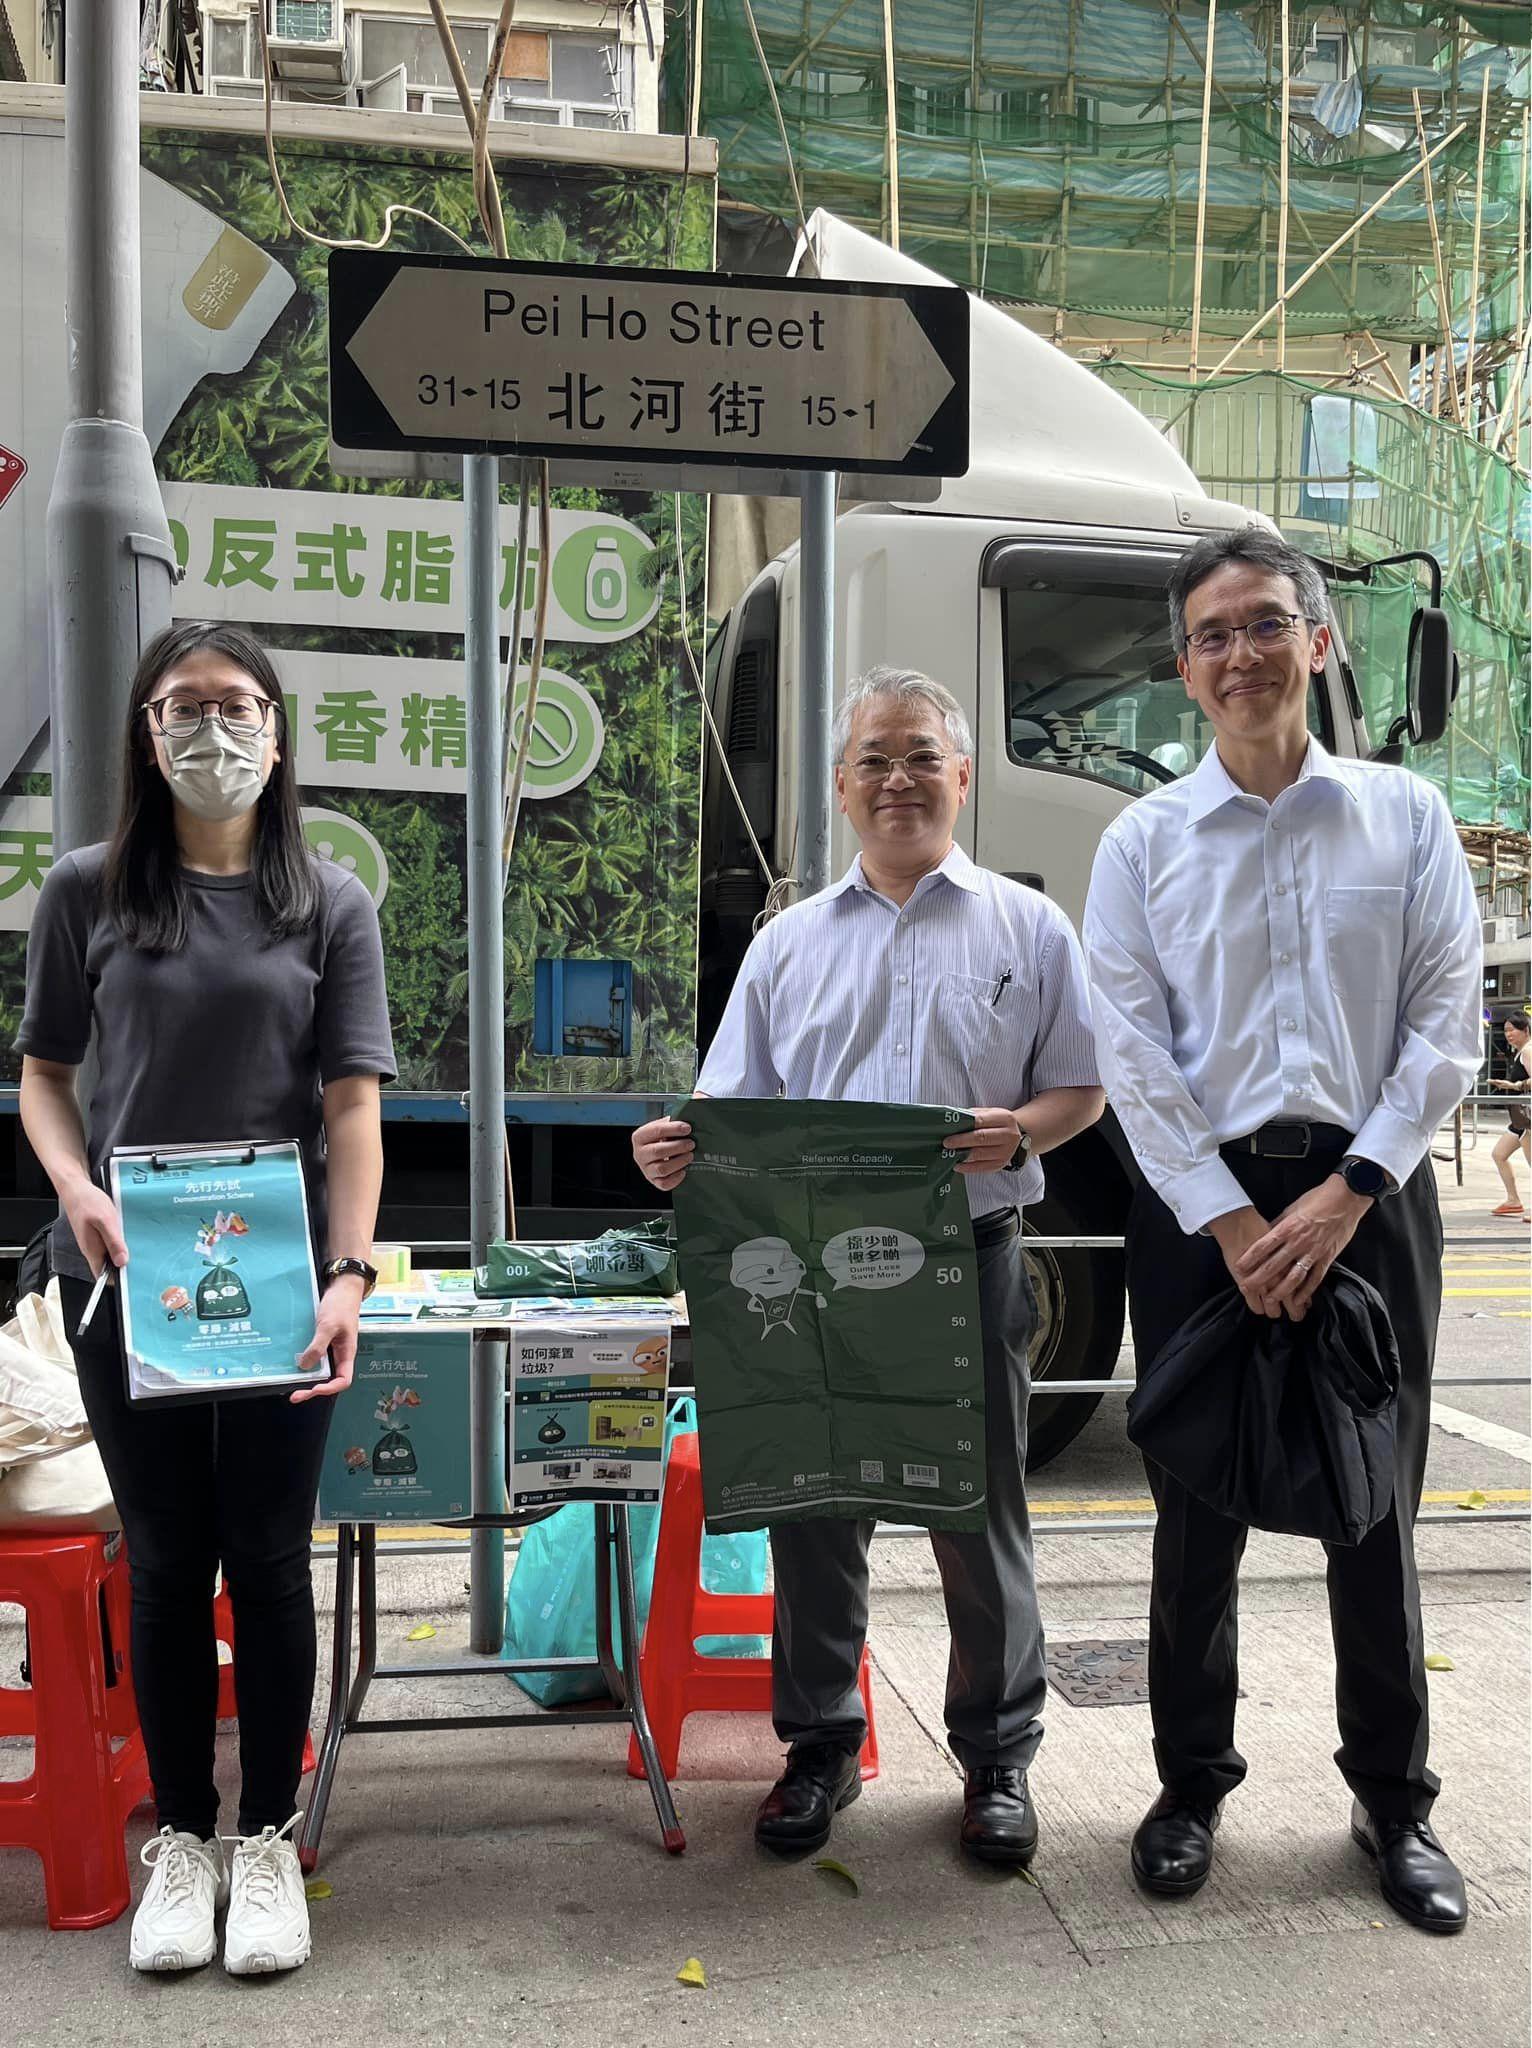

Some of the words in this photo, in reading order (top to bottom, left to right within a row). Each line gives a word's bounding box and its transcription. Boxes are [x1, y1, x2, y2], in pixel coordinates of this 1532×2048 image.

[484, 288, 559, 337] Pei
[581, 295, 647, 341] Ho
[669, 300, 825, 351] Street
[547, 371, 765, 438] 北河街
[286, 690, 466, 769] 香精
[944, 1111, 960, 1123] 50
[801, 1154, 850, 1163] Reference
[852, 1153, 893, 1165] Capacity
[185, 1180, 240, 1193] 先行先試
[939, 1184, 951, 1197] 50
[943, 1224, 959, 1236] 50
[506, 1265, 531, 1277] 100
[850, 1264, 876, 1274] Dump
[879, 1263, 900, 1271] Less
[851, 1273, 875, 1281] Save
[877, 1271, 901, 1279] More
[936, 1266, 963, 1285] 50
[951, 1316, 967, 1327] 50
[521, 1347, 574, 1360] 如何棄置
[369, 1359, 418, 1371] 先行先試
[954, 1356, 969, 1368] 50
[956, 1398, 971, 1409] 50
[957, 1440, 972, 1452] 50
[959, 1481, 973, 1492] 50
